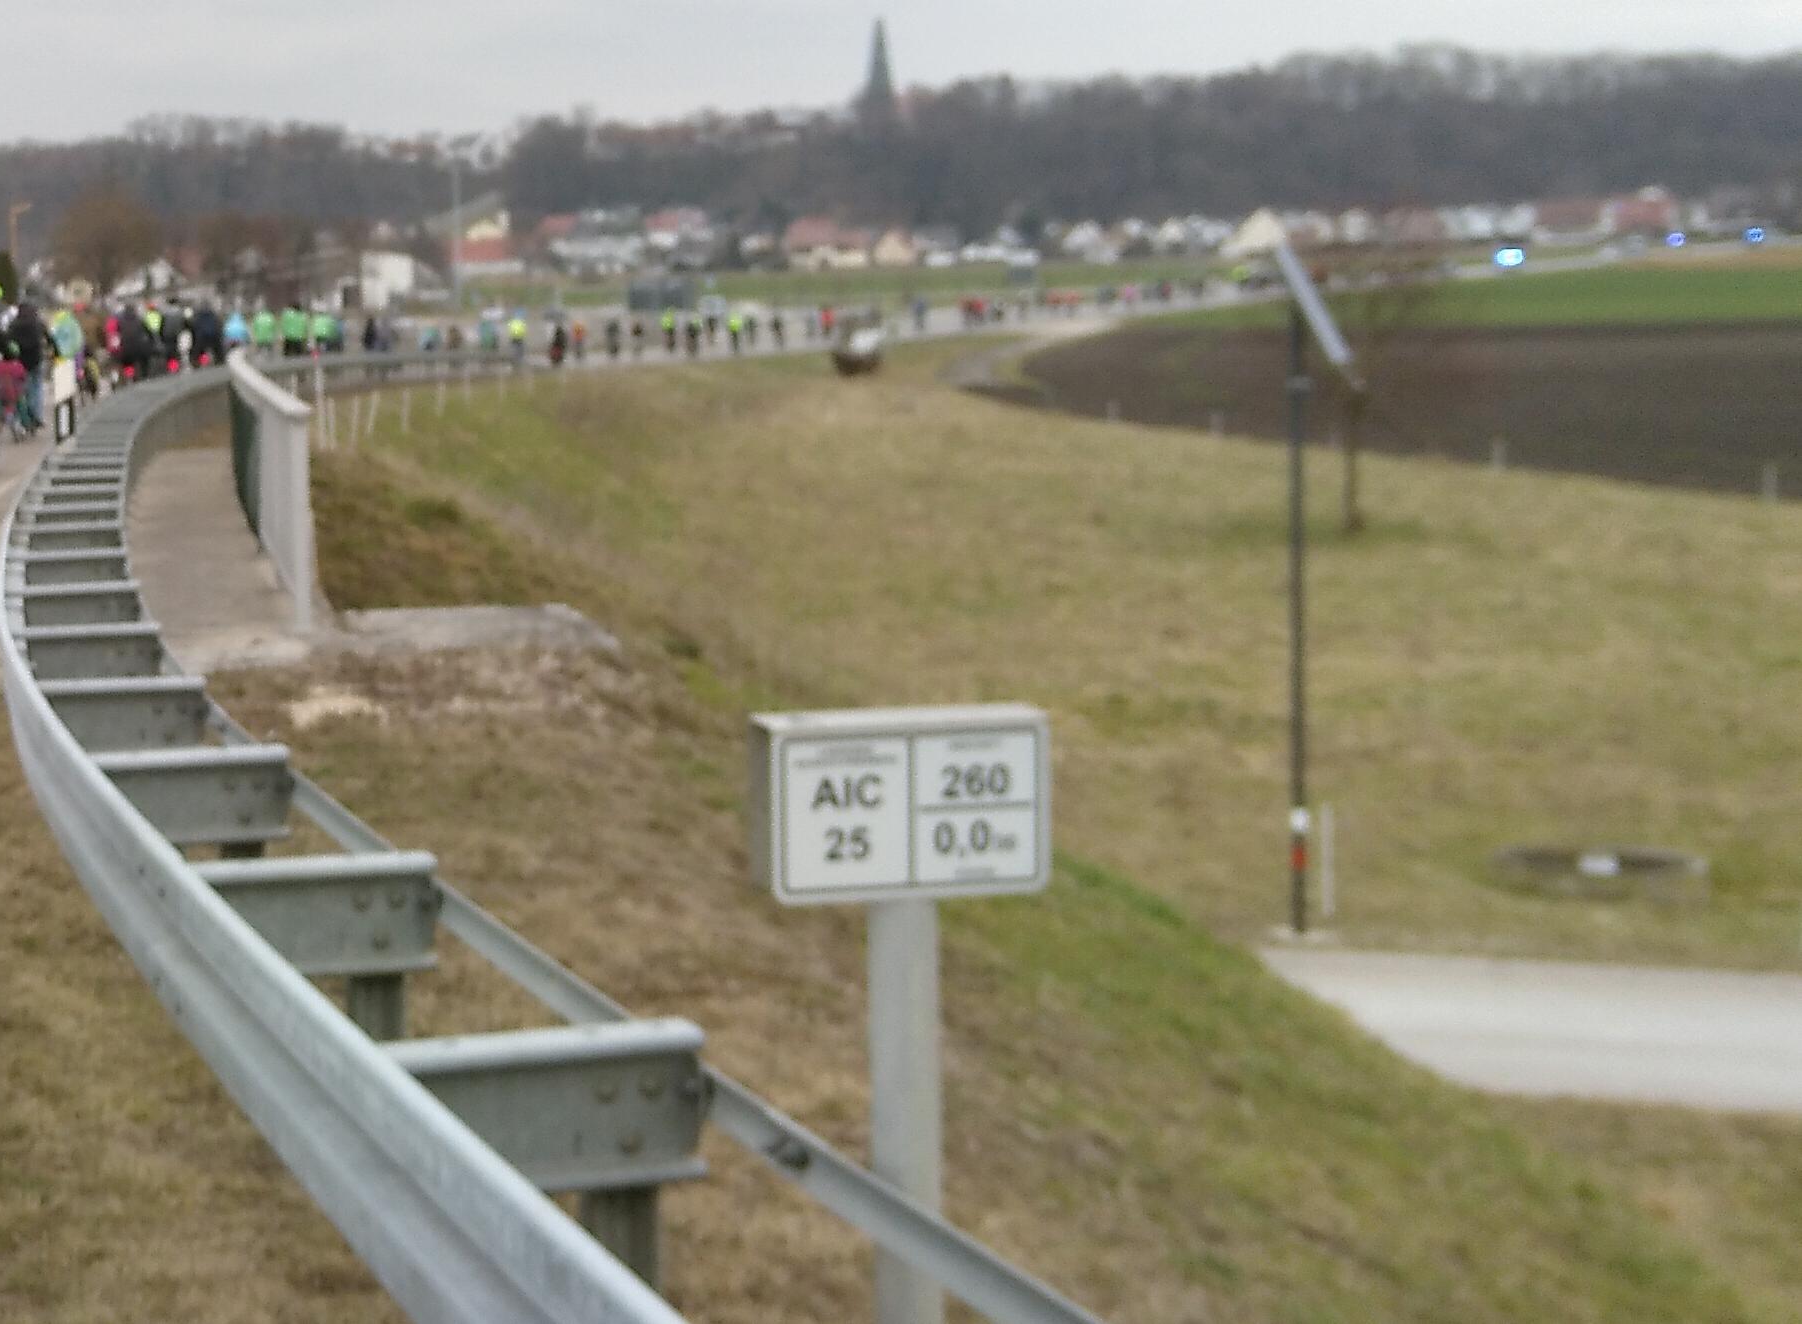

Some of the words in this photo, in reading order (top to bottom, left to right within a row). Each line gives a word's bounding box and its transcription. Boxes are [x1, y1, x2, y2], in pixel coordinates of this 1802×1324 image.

[812, 773, 884, 810] AIC
[942, 762, 1010, 799] 260
[824, 826, 870, 861] 25
